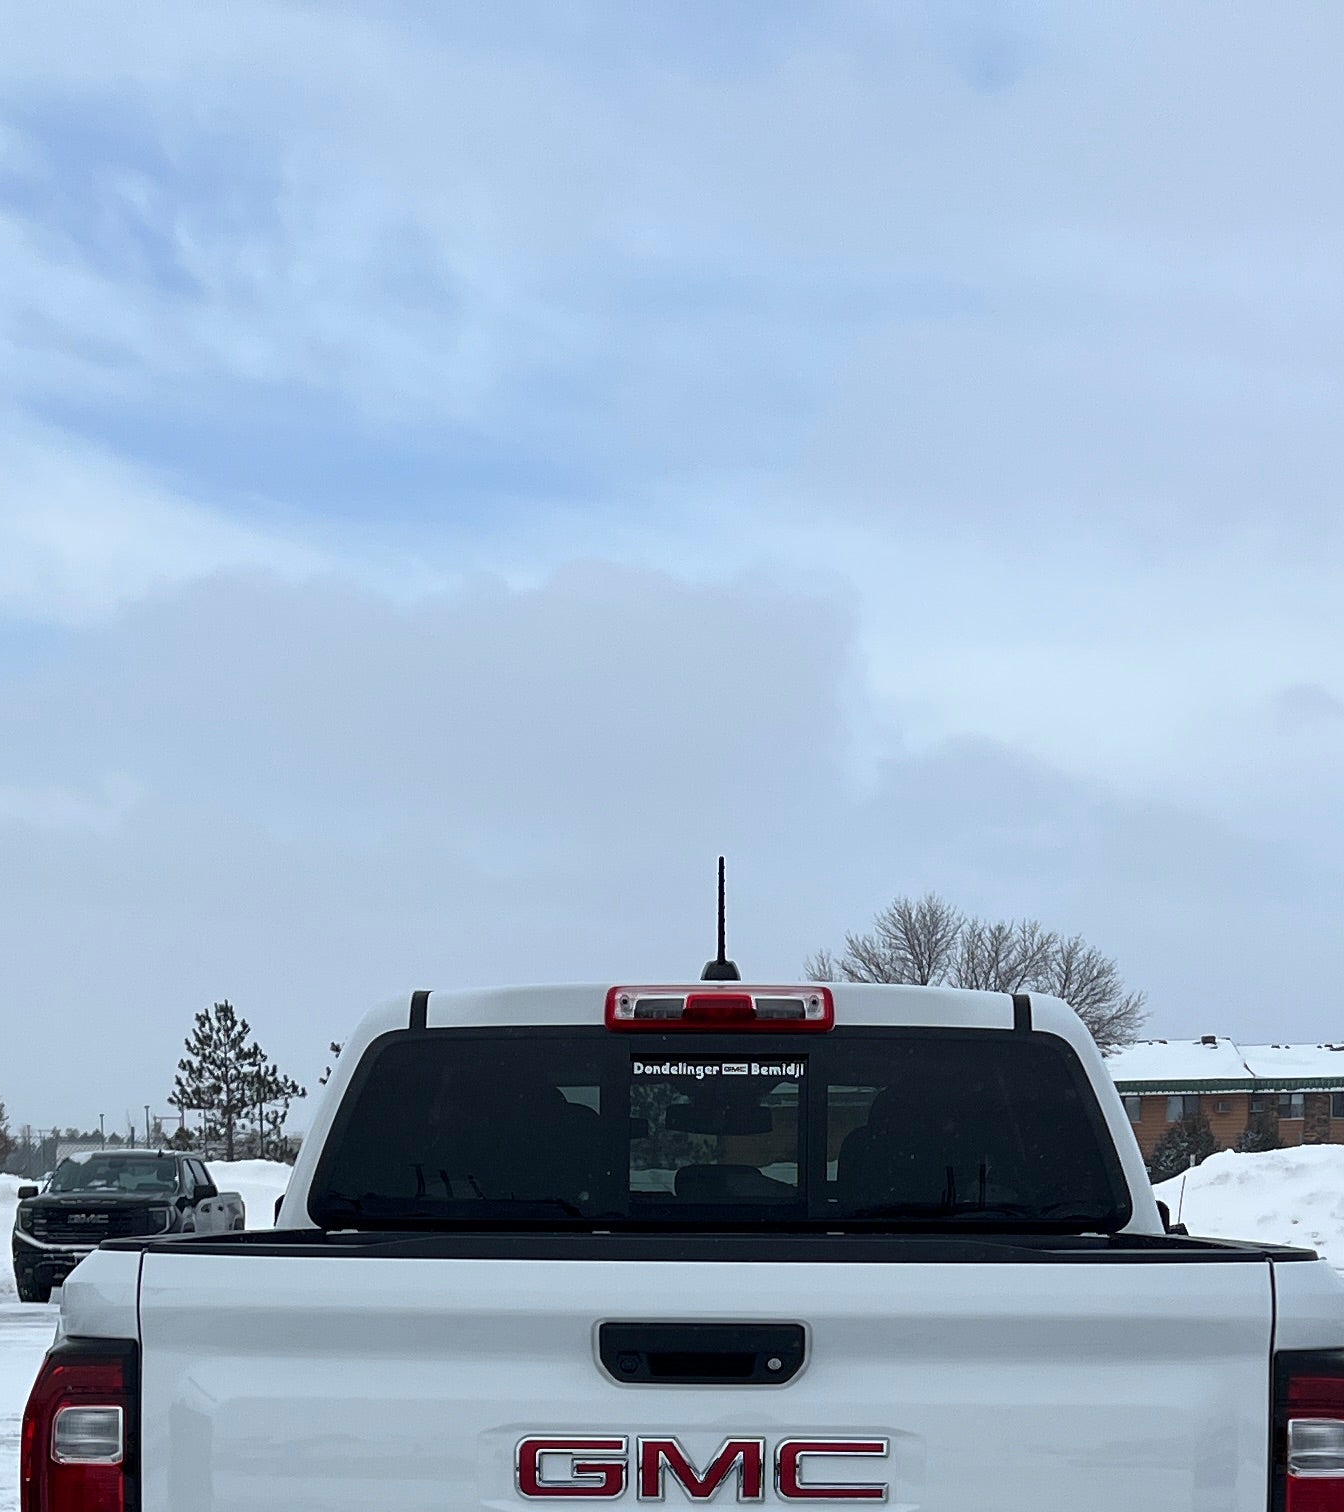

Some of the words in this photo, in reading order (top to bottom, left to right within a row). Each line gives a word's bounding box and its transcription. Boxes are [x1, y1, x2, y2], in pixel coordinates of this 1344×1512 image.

[633, 1062, 720, 1079] Dondelinger
[751, 1063, 804, 1078] Bemidji
[514, 1434, 889, 1504] GMC
